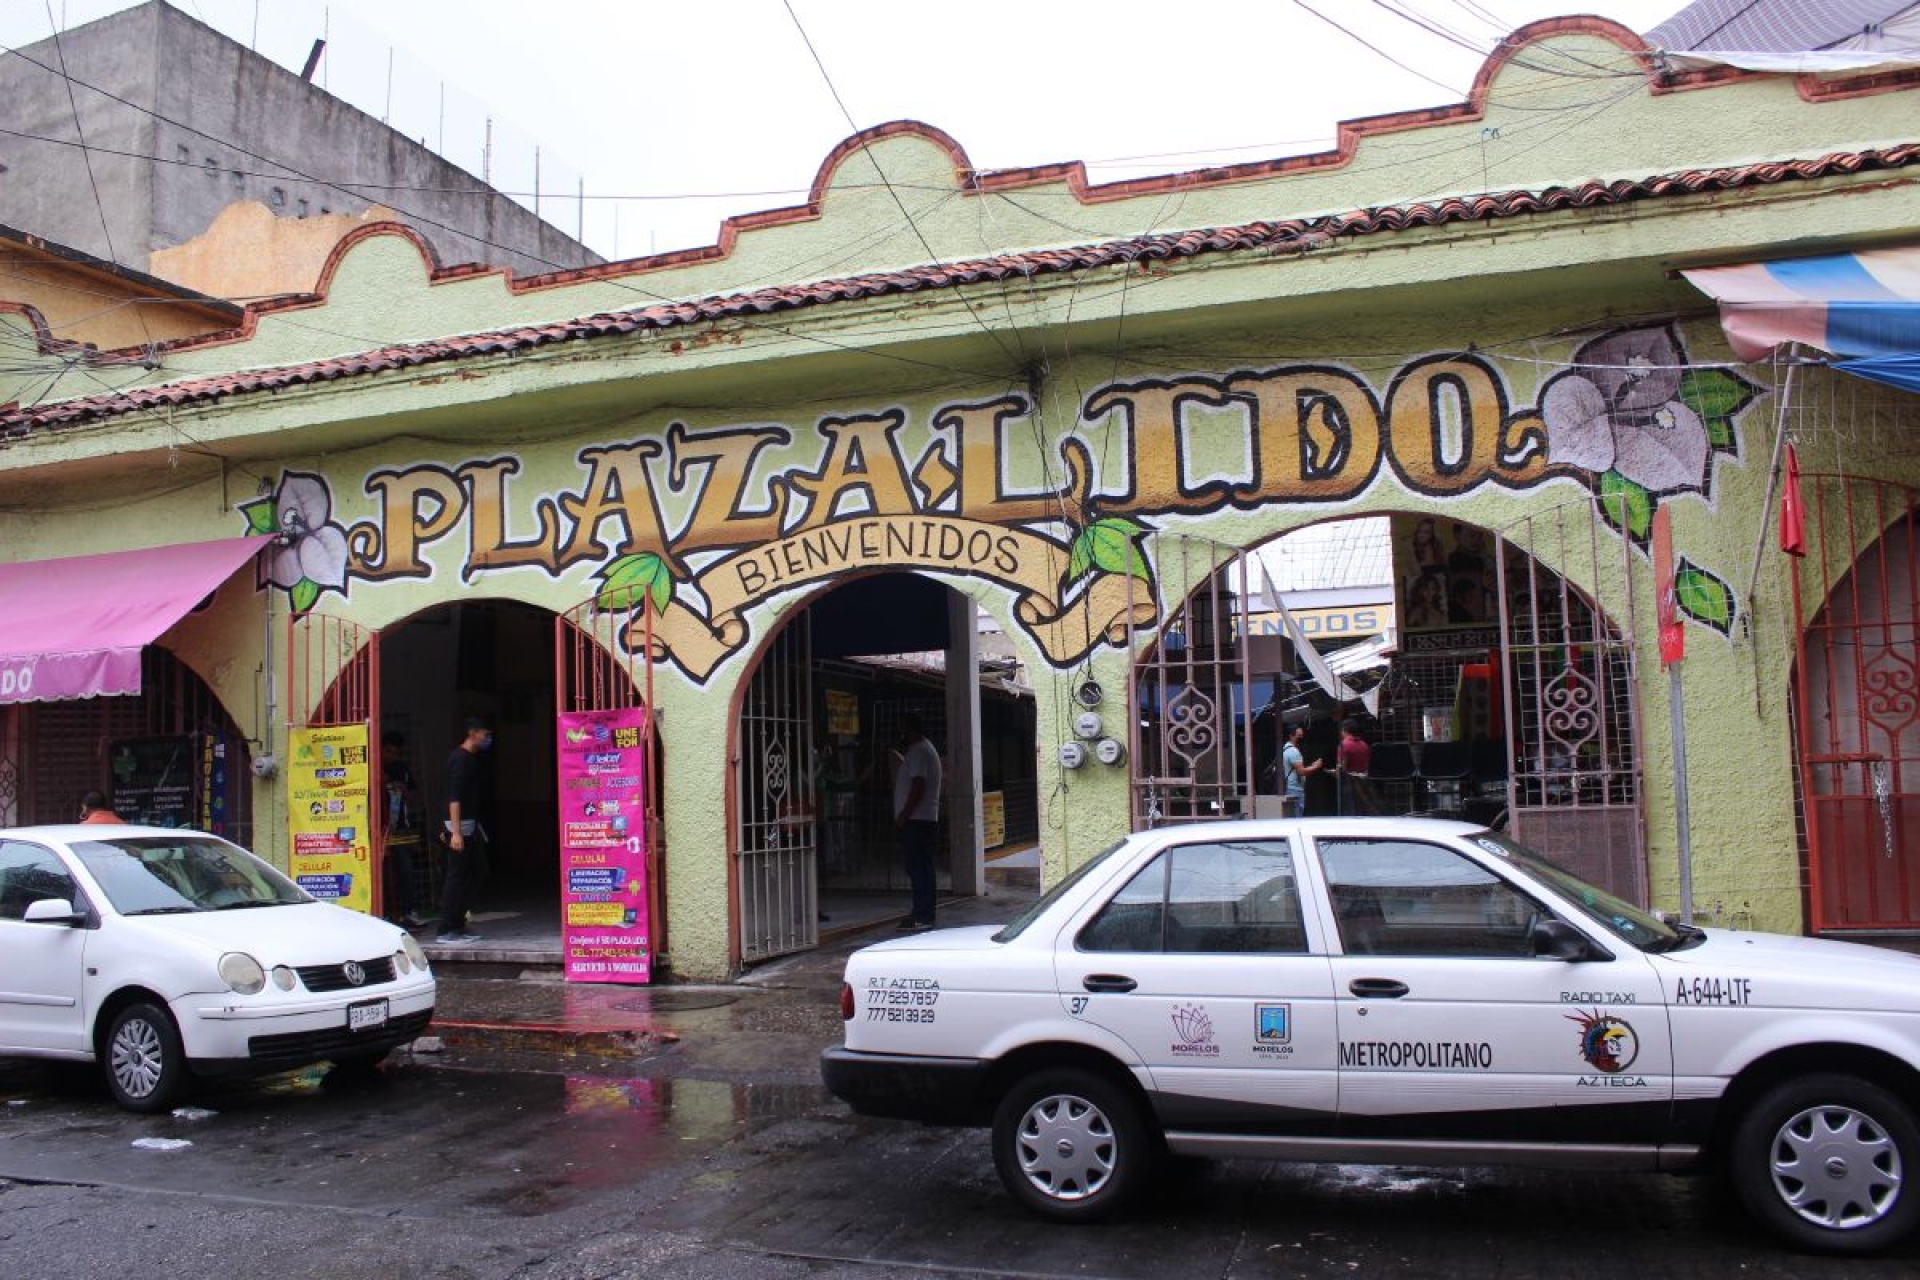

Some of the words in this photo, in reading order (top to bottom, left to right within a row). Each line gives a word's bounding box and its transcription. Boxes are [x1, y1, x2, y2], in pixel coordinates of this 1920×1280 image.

[350, 409, 917, 582] PLAZA
[932, 352, 1548, 520] LIDO
[735, 521, 1020, 597] BIENVENIDOS
[1237, 611, 1378, 636] ENDOS
[570, 854, 606, 865] CELULAR
[890, 978, 940, 990] AZTECA
[1676, 977, 1752, 1004] A-644-LTF
[1071, 996, 1089, 1014] 37
[1560, 991, 1602, 1004] RADIO
[1605, 992, 1636, 1004] TAXI
[1171, 1045, 1220, 1053] MORELOS
[1252, 1045, 1294, 1054] MORELOS
[1340, 1042, 1492, 1067] METROPOLITANO
[1577, 1076, 1647, 1087] AZTECA
